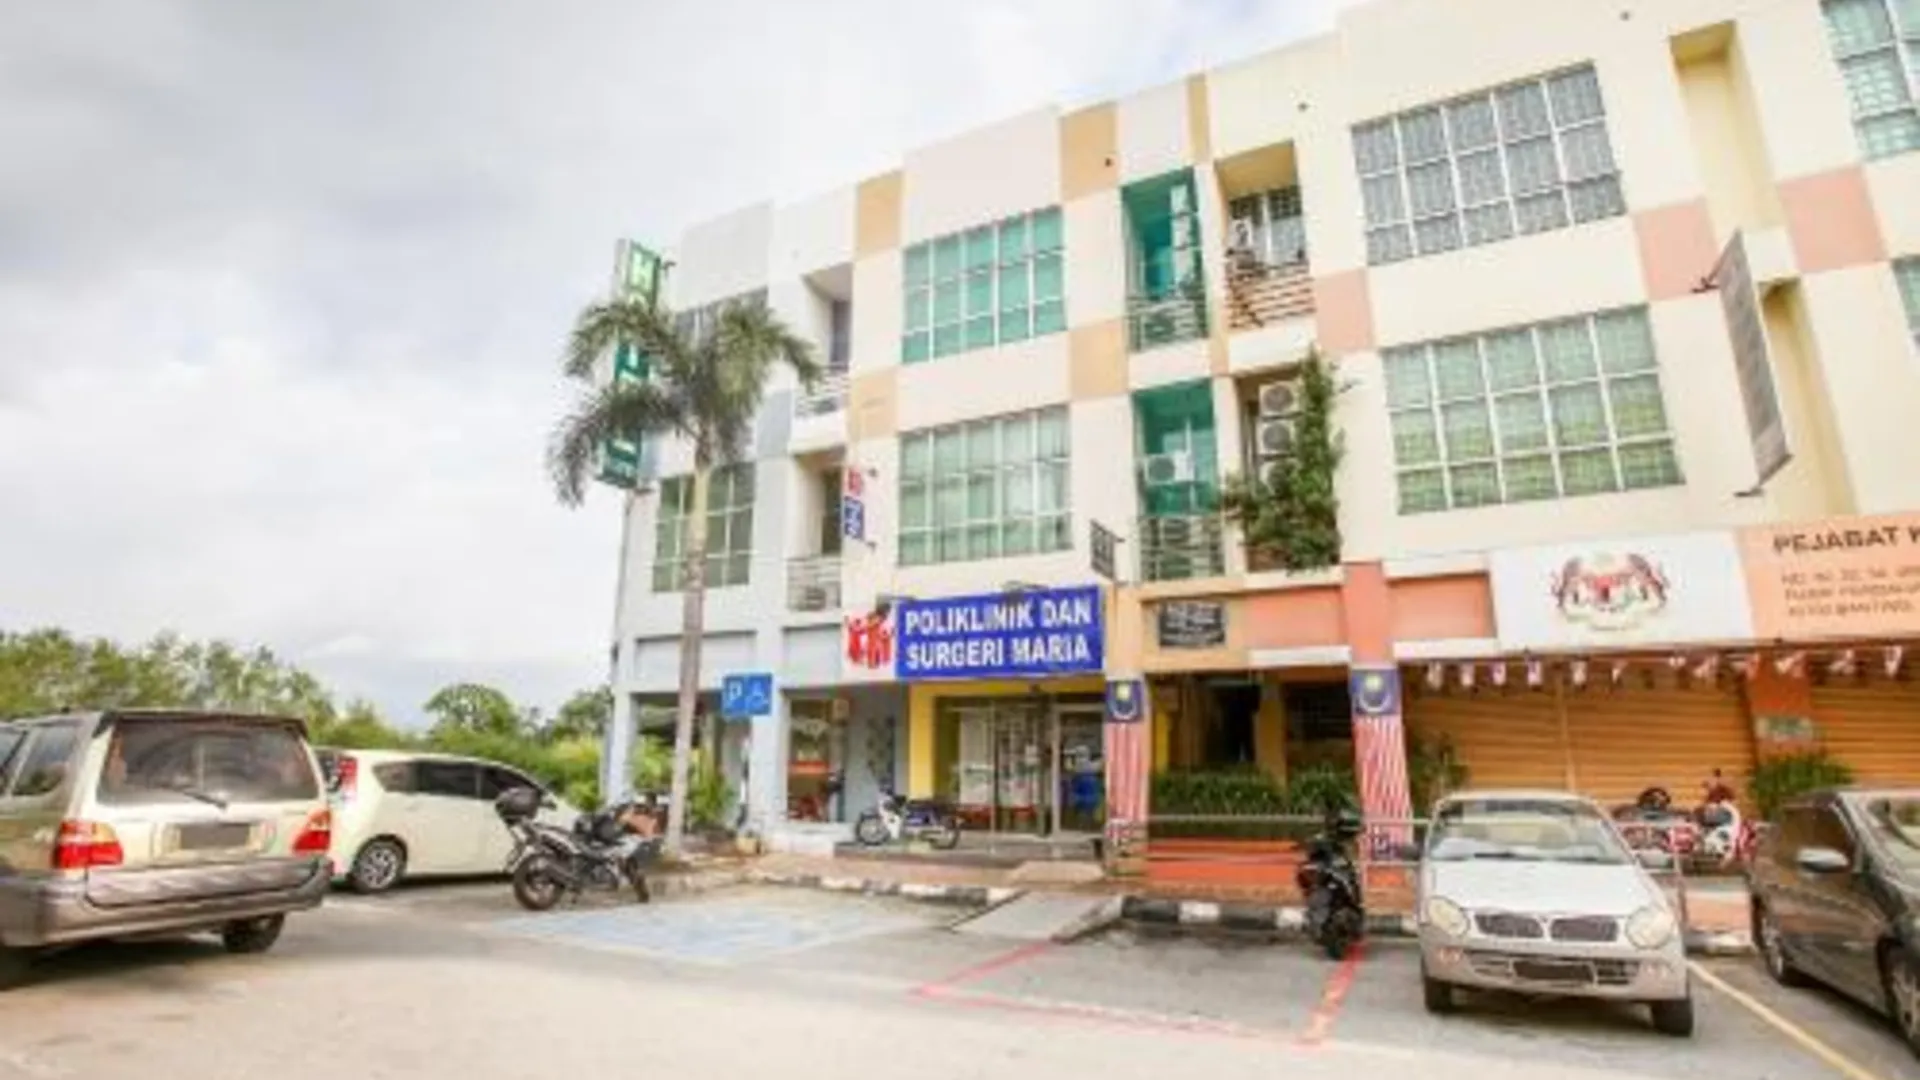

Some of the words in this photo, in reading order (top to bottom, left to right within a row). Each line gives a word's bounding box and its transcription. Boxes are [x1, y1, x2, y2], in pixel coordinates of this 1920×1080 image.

[1774, 526, 1898, 553] PEJABAT
[904, 600, 1034, 636] POLIKLINIK
[1040, 596, 1092, 628] DAN
[906, 637, 1004, 670] SURGERI
[1011, 633, 1092, 665] MARIA
